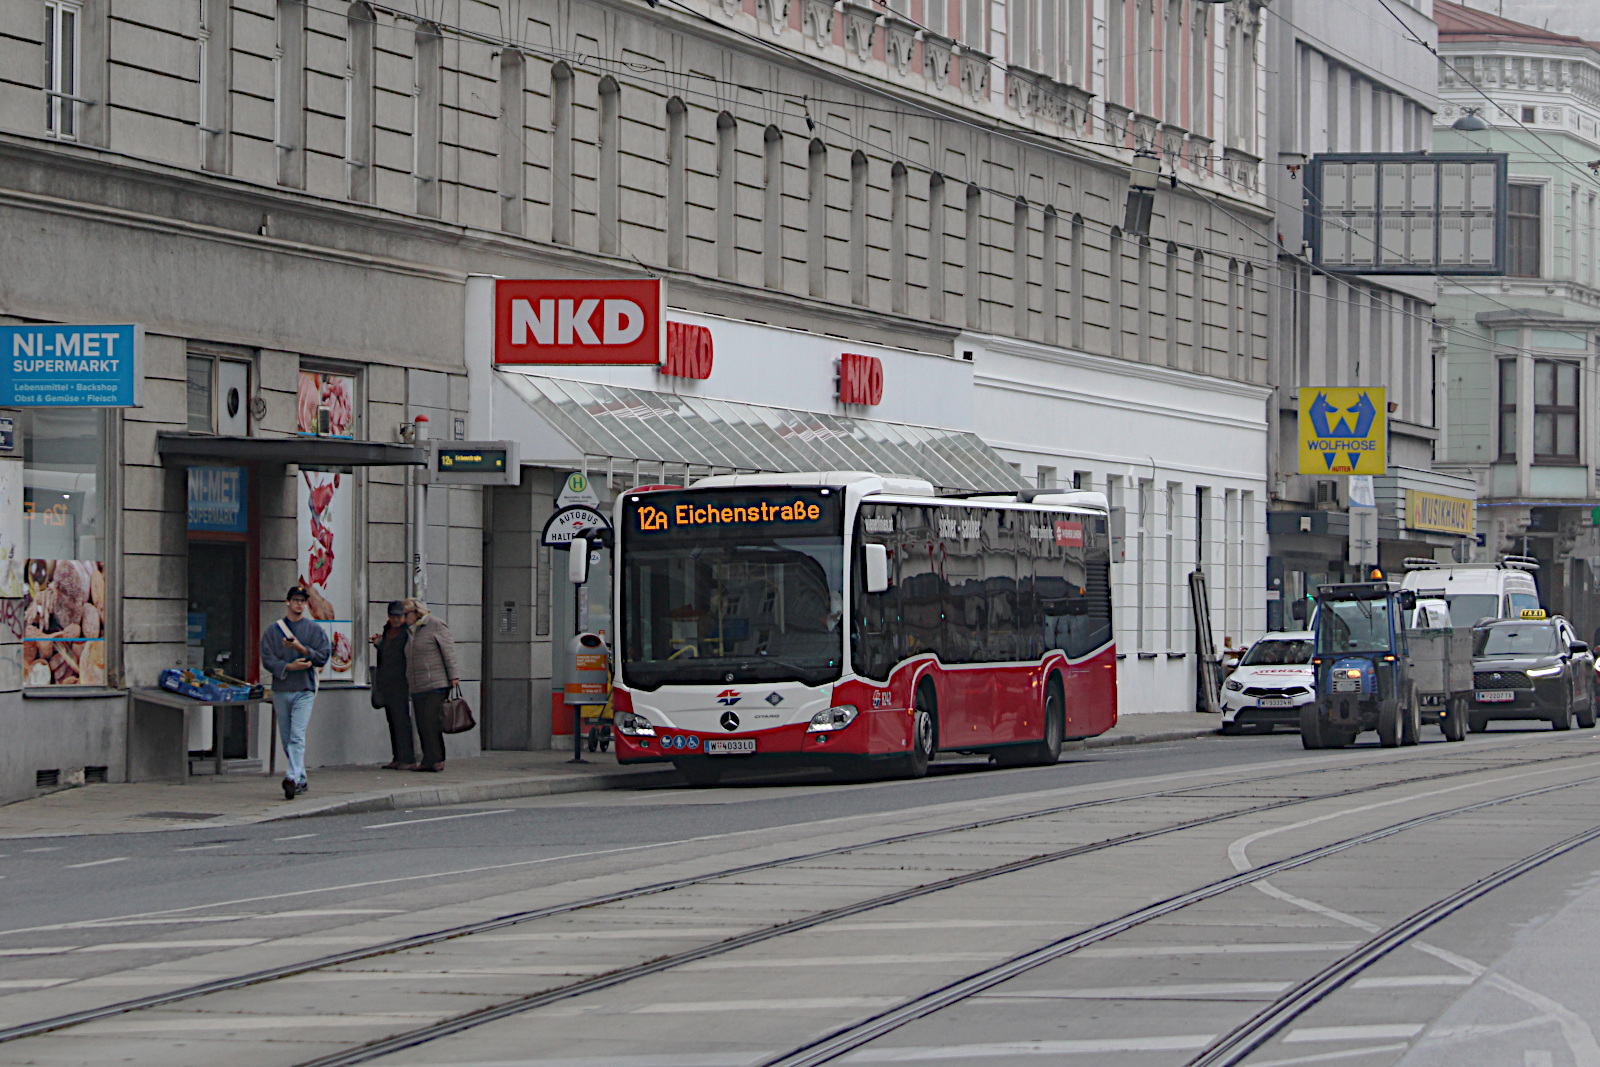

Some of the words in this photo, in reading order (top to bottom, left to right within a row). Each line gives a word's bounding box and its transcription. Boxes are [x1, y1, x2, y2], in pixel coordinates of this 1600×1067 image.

[511, 299, 645, 345] NKD
[13, 333, 120, 357] NI-MET
[663, 320, 713, 380] NKD
[13, 359, 120, 372] SUPERMARKT
[14, 383, 69, 391] Lebensmittel
[76, 383, 118, 392] Backshop
[841, 353, 883, 406] NKD
[14, 394, 36, 402] Obst
[36, 394, 43, 402] &
[44, 394, 80, 402] Gemüse
[87, 394, 118, 402] Fleisch
[1307, 440, 1376, 451] WOLFHOSE
[188, 469, 239, 503] NI-MET
[573, 477, 583, 488] H
[188, 507, 239, 525] SUPERMARKT
[559, 511, 599, 525] AUTOBUS
[638, 506, 668, 530] 12A
[675, 501, 820, 525] Eichenstraße
[1421, 497, 1467, 530] MUSIKHAUS
[940, 513, 957, 538] sicher
[961, 515, 981, 538] sauber
[711, 742, 717, 750] W
